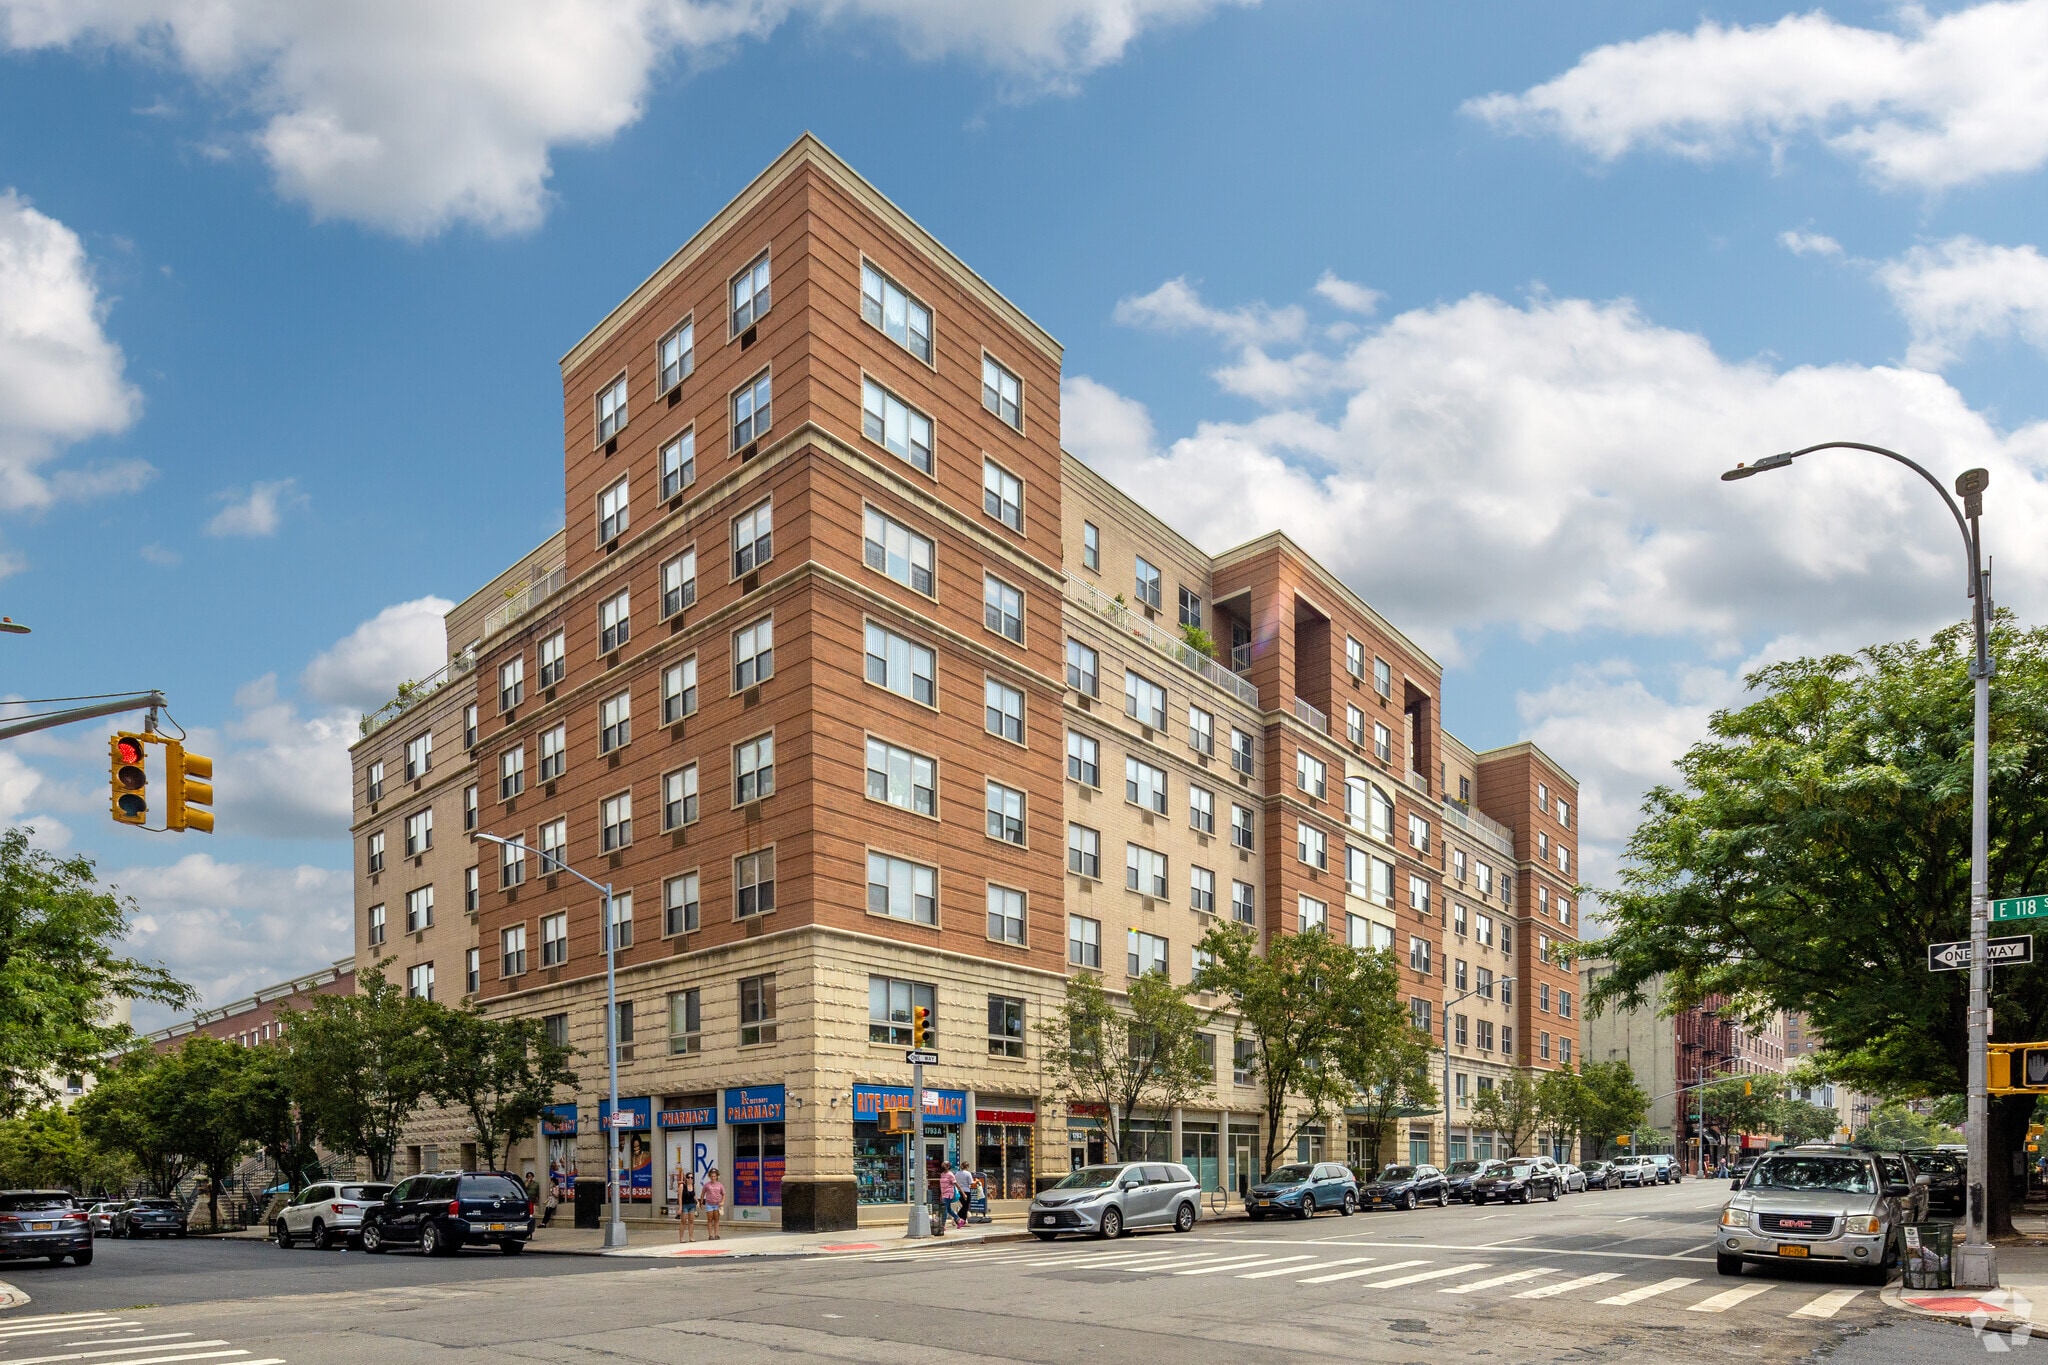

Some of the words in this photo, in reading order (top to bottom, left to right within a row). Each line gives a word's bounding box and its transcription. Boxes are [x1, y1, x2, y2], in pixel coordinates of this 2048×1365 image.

[1999, 902, 2008, 918] E
[2015, 899, 2037, 916] 118
[1945, 950, 1971, 962] ONE
[1987, 945, 2018, 957] WAY
[728, 1103, 782, 1120] PHARMACY
[857, 1092, 881, 1113] RITE
[912, 1096, 963, 1116] ARMACY
[661, 1109, 710, 1125] PHARMACY
[1779, 1219, 1813, 1228] GMC
